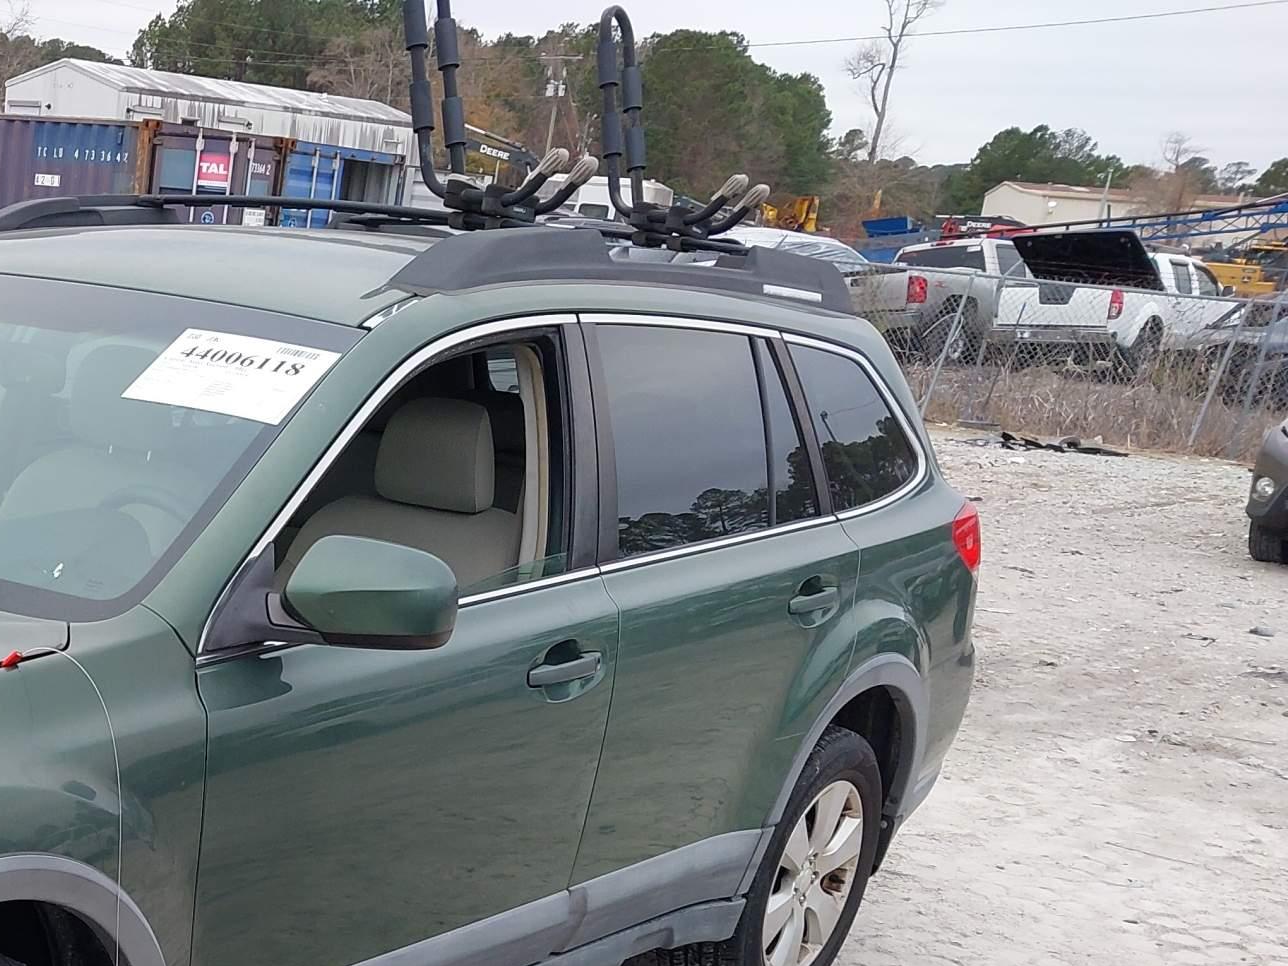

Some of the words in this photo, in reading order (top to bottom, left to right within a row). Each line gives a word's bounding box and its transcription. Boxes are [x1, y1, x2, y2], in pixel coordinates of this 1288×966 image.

[479, 144, 511, 160] DEERE
[199, 162, 228, 175] TAL
[180, 345, 306, 377] 44006118
